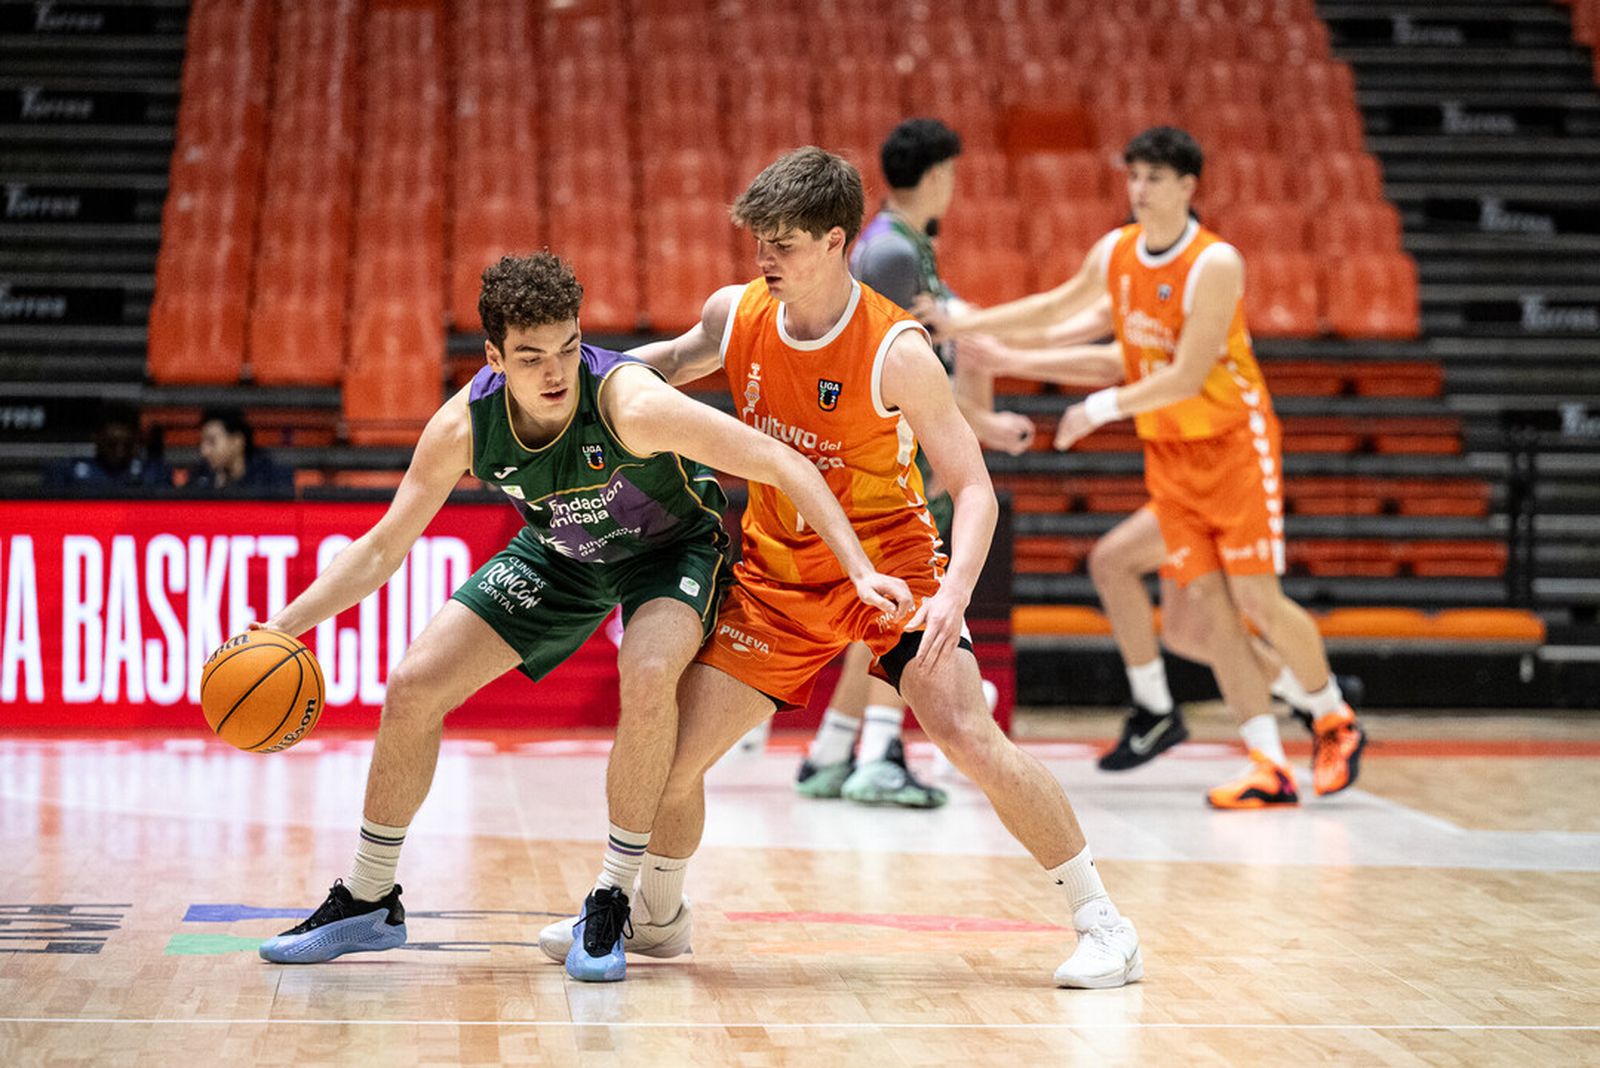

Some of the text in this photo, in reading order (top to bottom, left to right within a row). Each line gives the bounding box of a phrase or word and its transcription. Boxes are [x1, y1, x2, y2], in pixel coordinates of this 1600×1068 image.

[478, 581, 516, 615] DENTAL
[0, 534, 44, 703] A
[62, 534, 300, 704] BASKET
[719, 624, 770, 654] PULEVA
